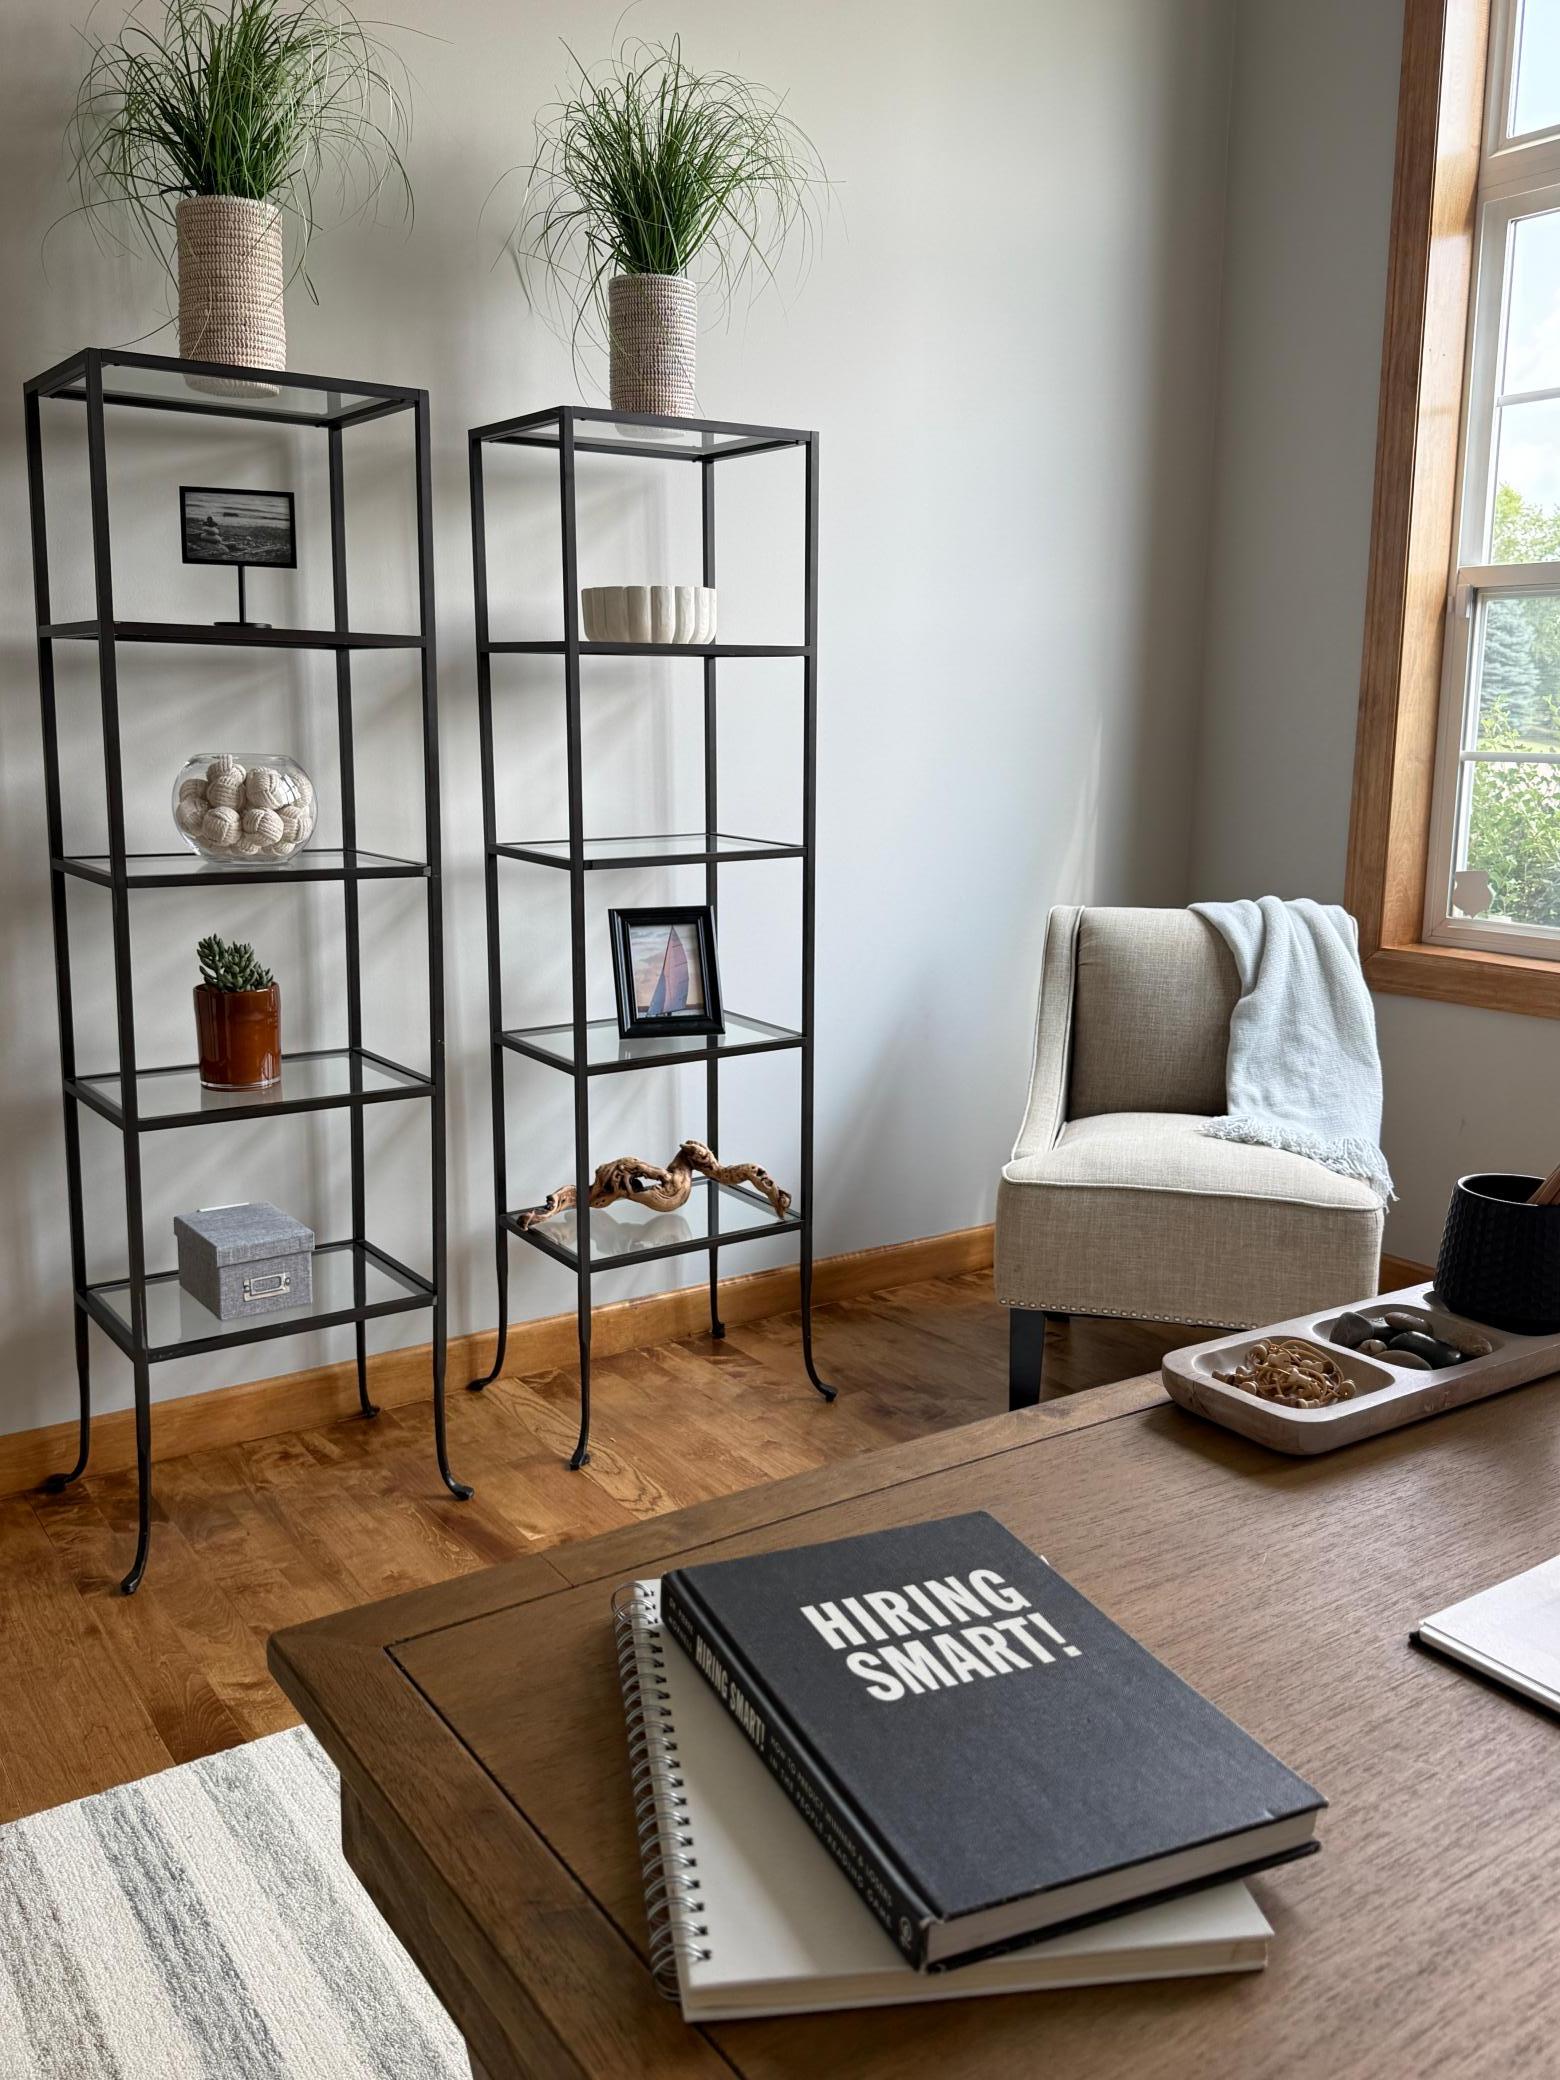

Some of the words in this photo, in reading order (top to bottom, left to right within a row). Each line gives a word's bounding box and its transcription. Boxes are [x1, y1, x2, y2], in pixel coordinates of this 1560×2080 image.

[800, 1569, 1032, 1650] HIRING
[695, 1634, 728, 1700] HIRING
[729, 1681, 766, 1752] SMART!
[846, 1612, 1082, 1701] SMART!
